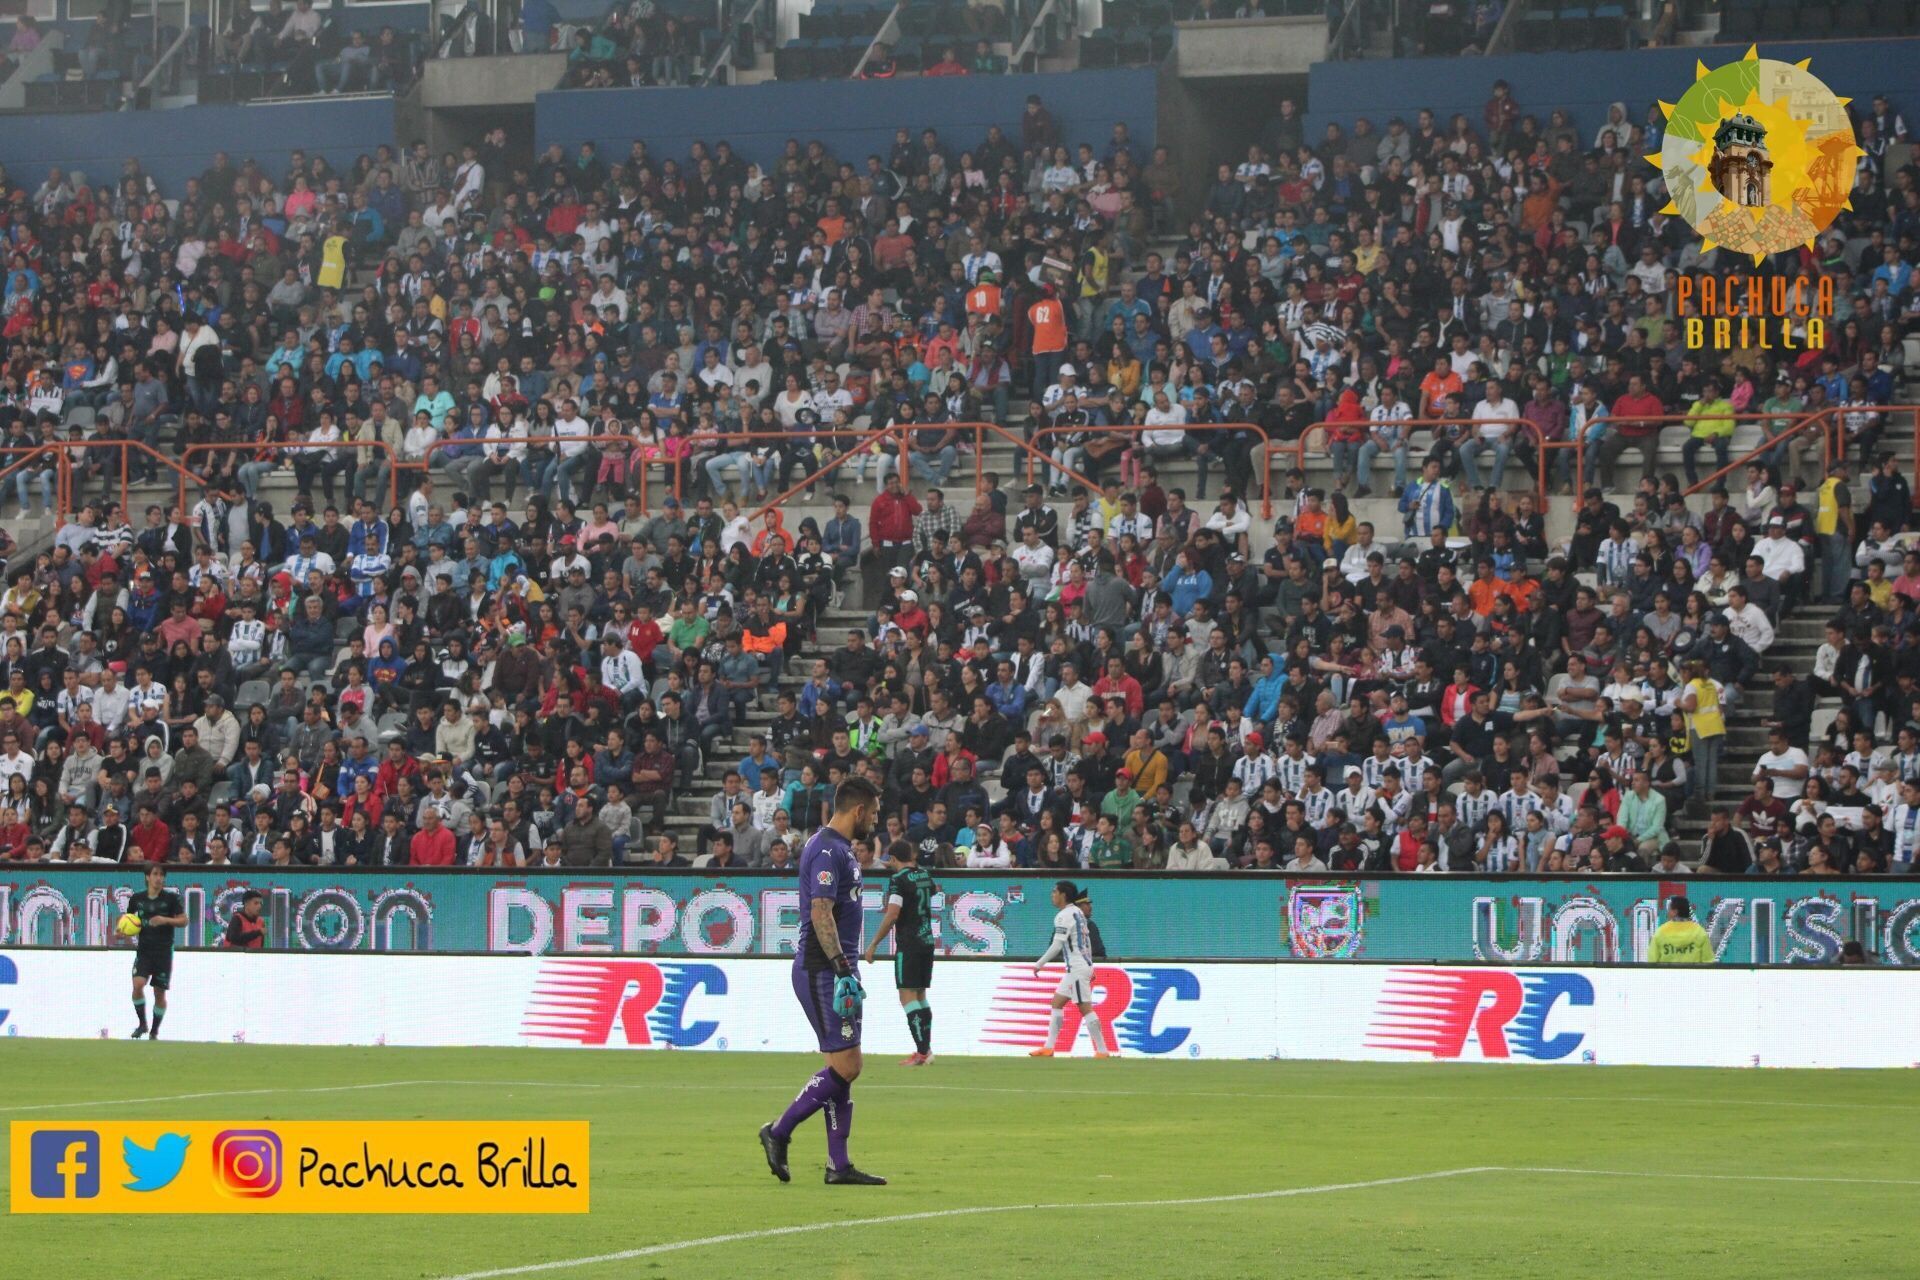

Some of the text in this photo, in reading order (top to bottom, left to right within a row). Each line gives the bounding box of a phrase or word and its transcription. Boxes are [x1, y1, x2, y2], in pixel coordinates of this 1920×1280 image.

[1036, 306, 1050, 323] 62
[489, 887, 1006, 957] DEPORS
[1663, 942, 1696, 955] STAFF
[519, 958, 728, 1047] RC
[1362, 968, 1595, 1061] RC
